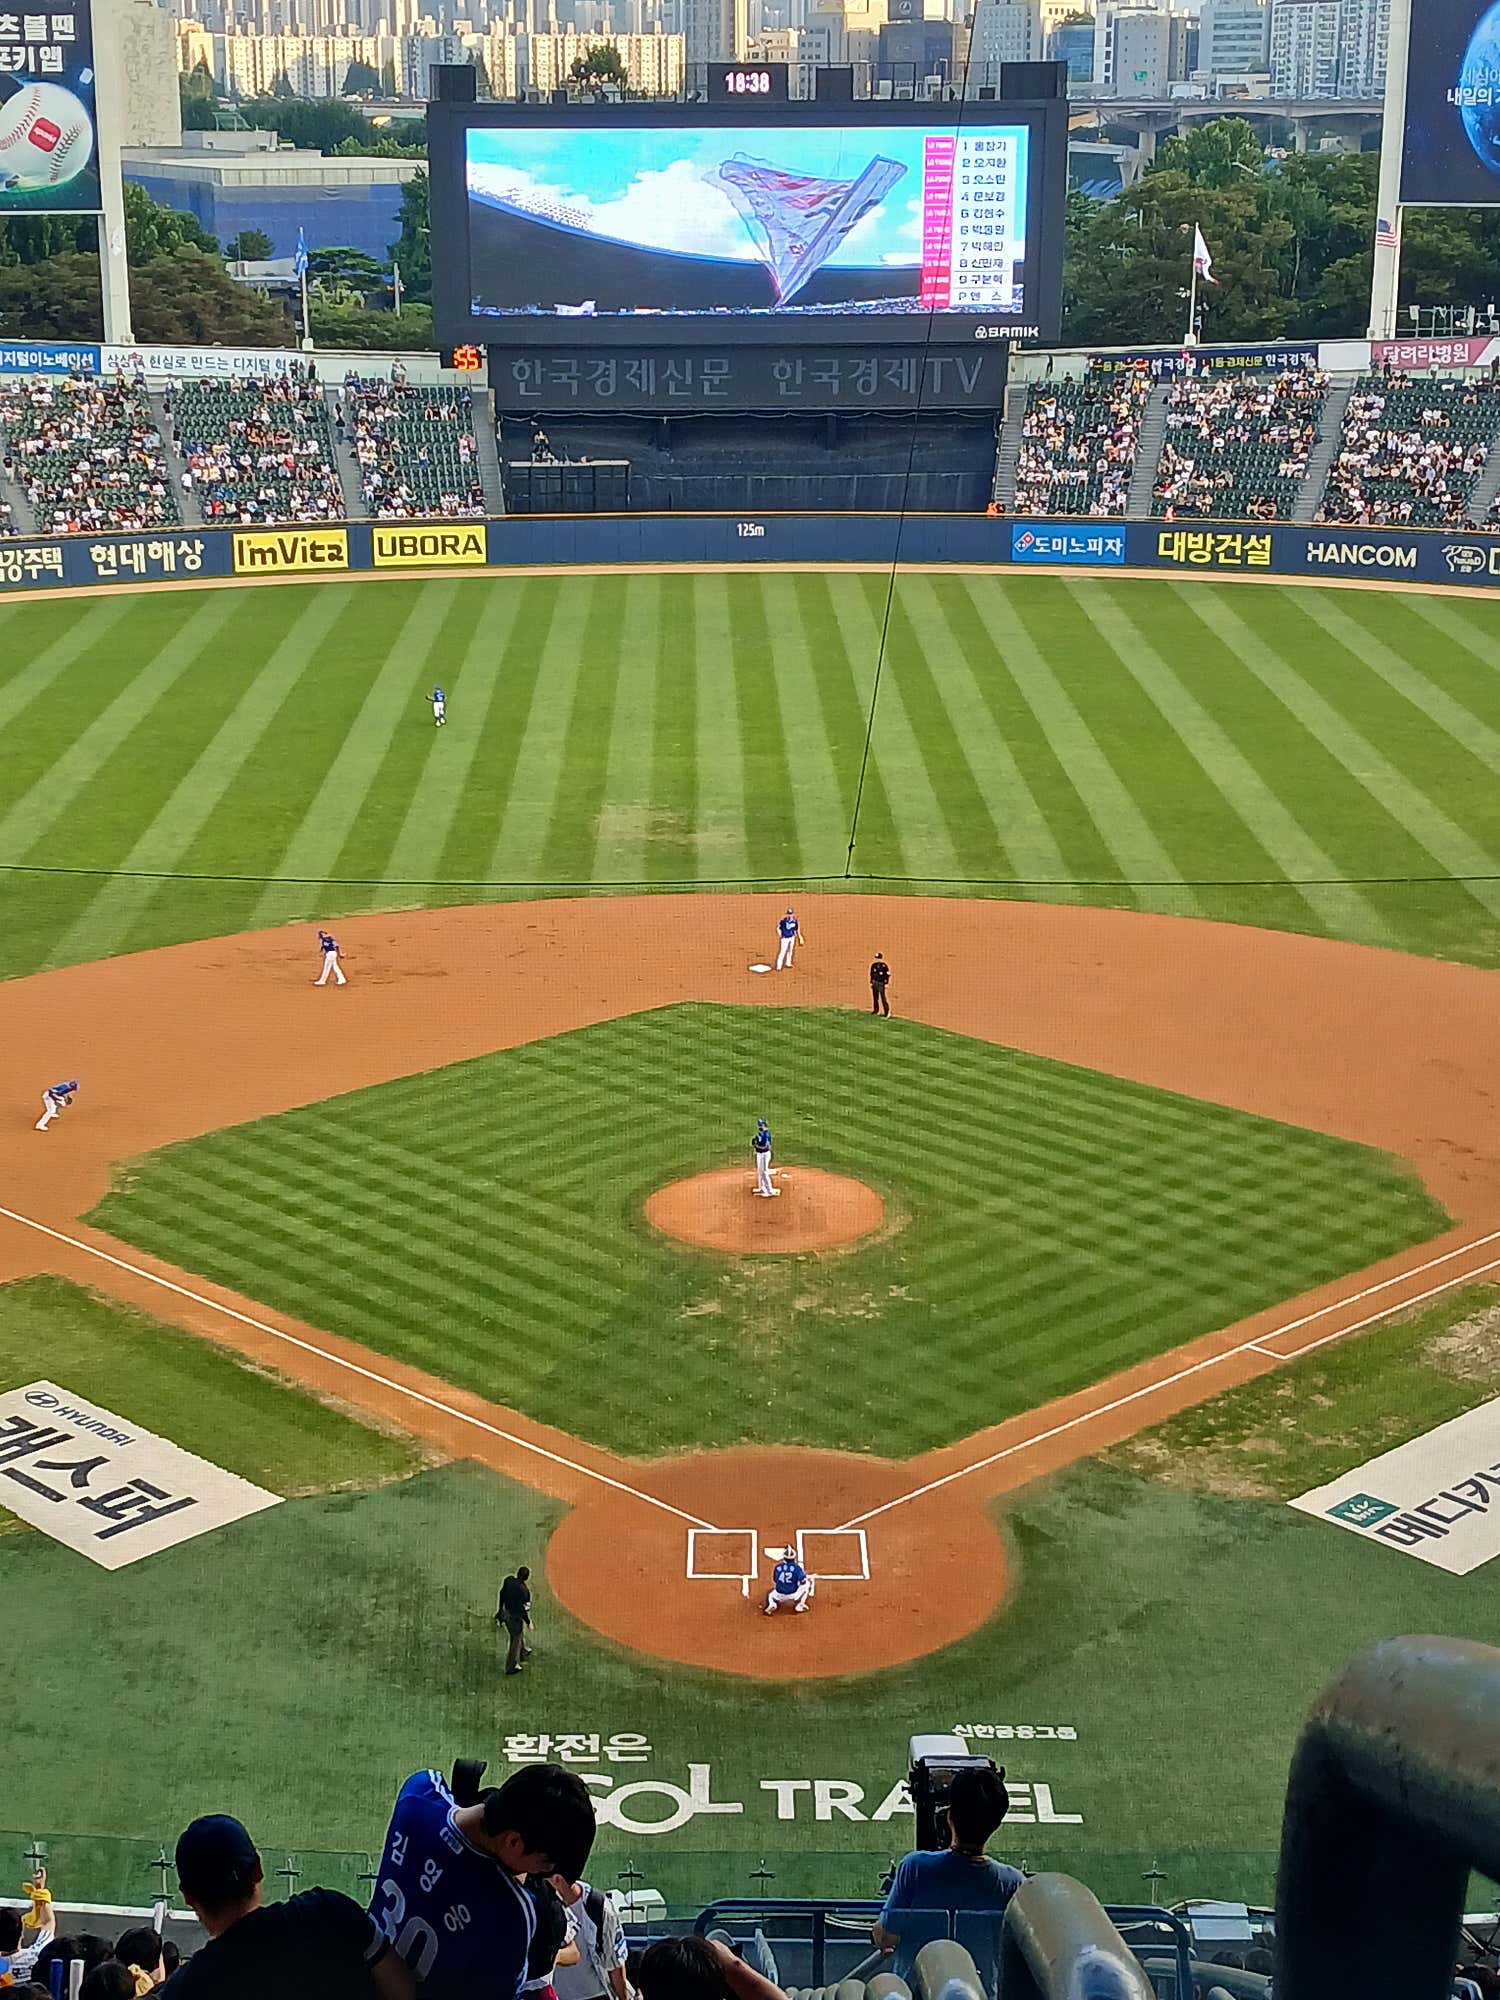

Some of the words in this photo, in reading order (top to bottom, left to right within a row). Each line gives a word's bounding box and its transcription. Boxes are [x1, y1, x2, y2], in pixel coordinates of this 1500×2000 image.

[725, 72, 770, 93] 18:38
[1447, 87, 1492, 106] 내일의
[988, 326, 1039, 338] SAMIK
[0, 351, 94, 368] 지털이노베이션
[107, 353, 144, 369] 상상
[233, 357, 270, 372] 디지털
[1383, 343, 1469, 364] 달려라병원
[511, 358, 732, 396] 한국경제신문
[771, 356, 983, 396] 한국경제TV
[736, 522, 765, 537] 125m
[377, 534, 483, 557] UBORA
[1033, 536, 1123, 556] 도미노피자
[1158, 531, 1272, 566] 대방건설
[1307, 541, 1417, 568] HANCOM
[0, 547, 63, 582] 강주택
[90, 539, 204, 576] 현대해상
[53, 1405, 137, 1447] HYUNDAI
[1374, 1463, 1500, 1546] 메디카
[778, 1571, 793, 1584] 42
[502, 1732, 652, 1763] 환전은
[760, 1779, 1083, 1824] TRAEL
